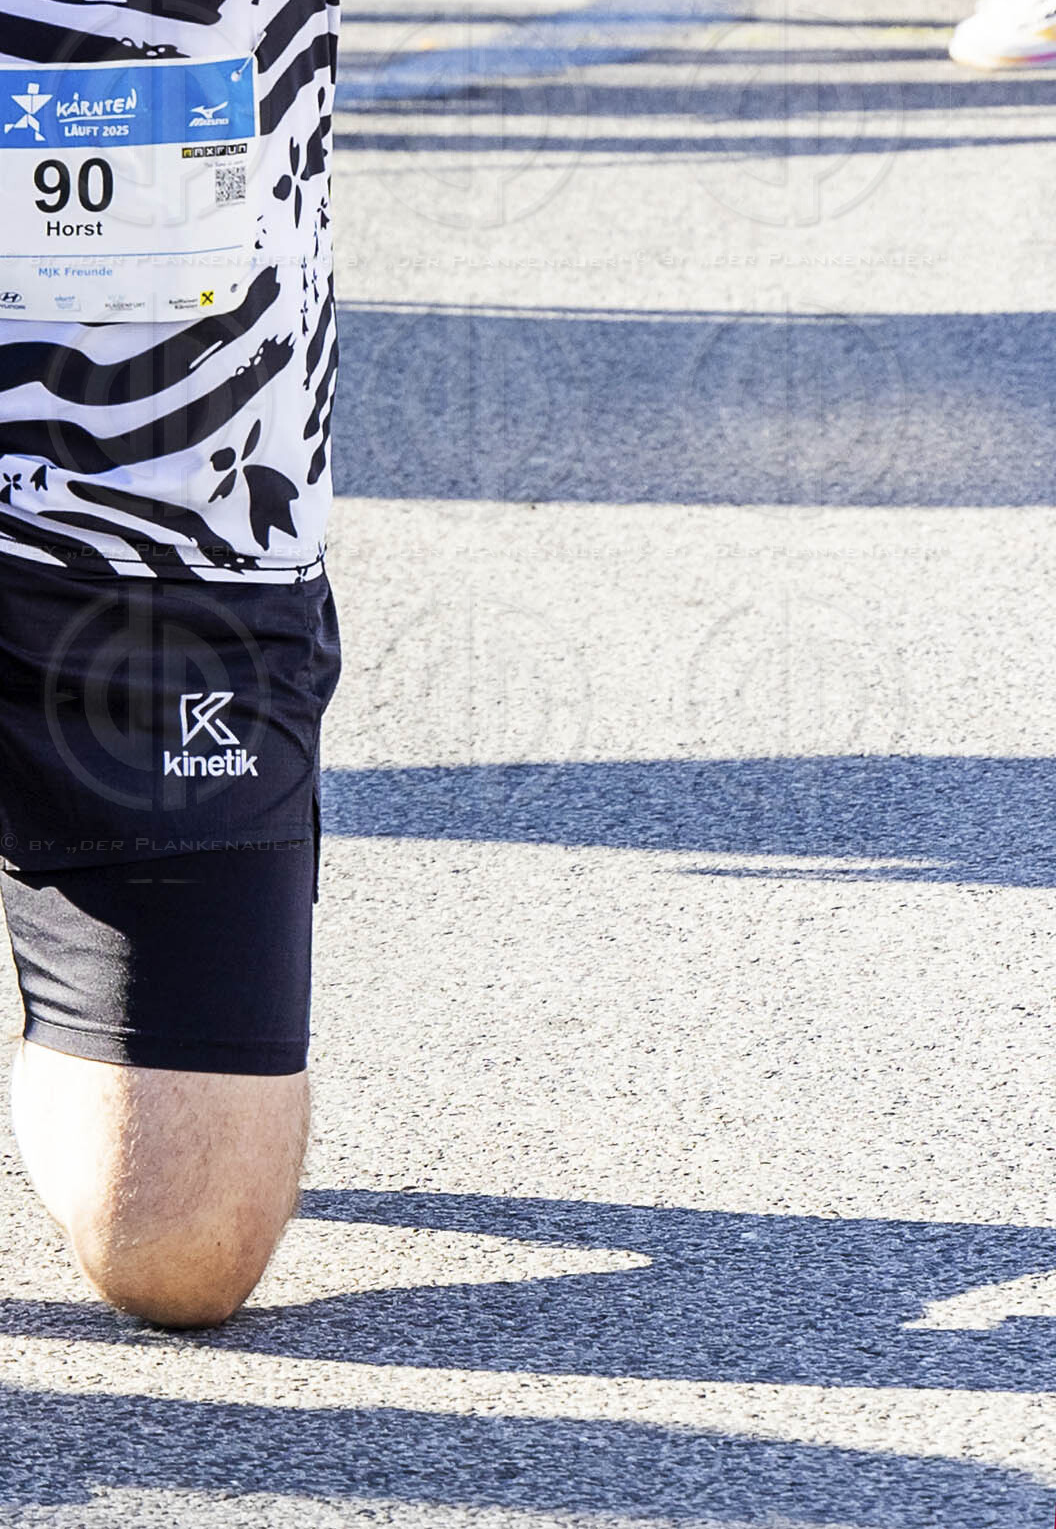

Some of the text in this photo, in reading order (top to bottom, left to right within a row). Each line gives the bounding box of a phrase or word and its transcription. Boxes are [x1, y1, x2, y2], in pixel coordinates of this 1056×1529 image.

[64, 125, 130, 137] LÄUFT 2025
[33, 157, 114, 213] 90
[46, 221, 103, 236] Horst
[38, 266, 113, 277] MJK Freunde
[164, 749, 259, 777] kinetik
